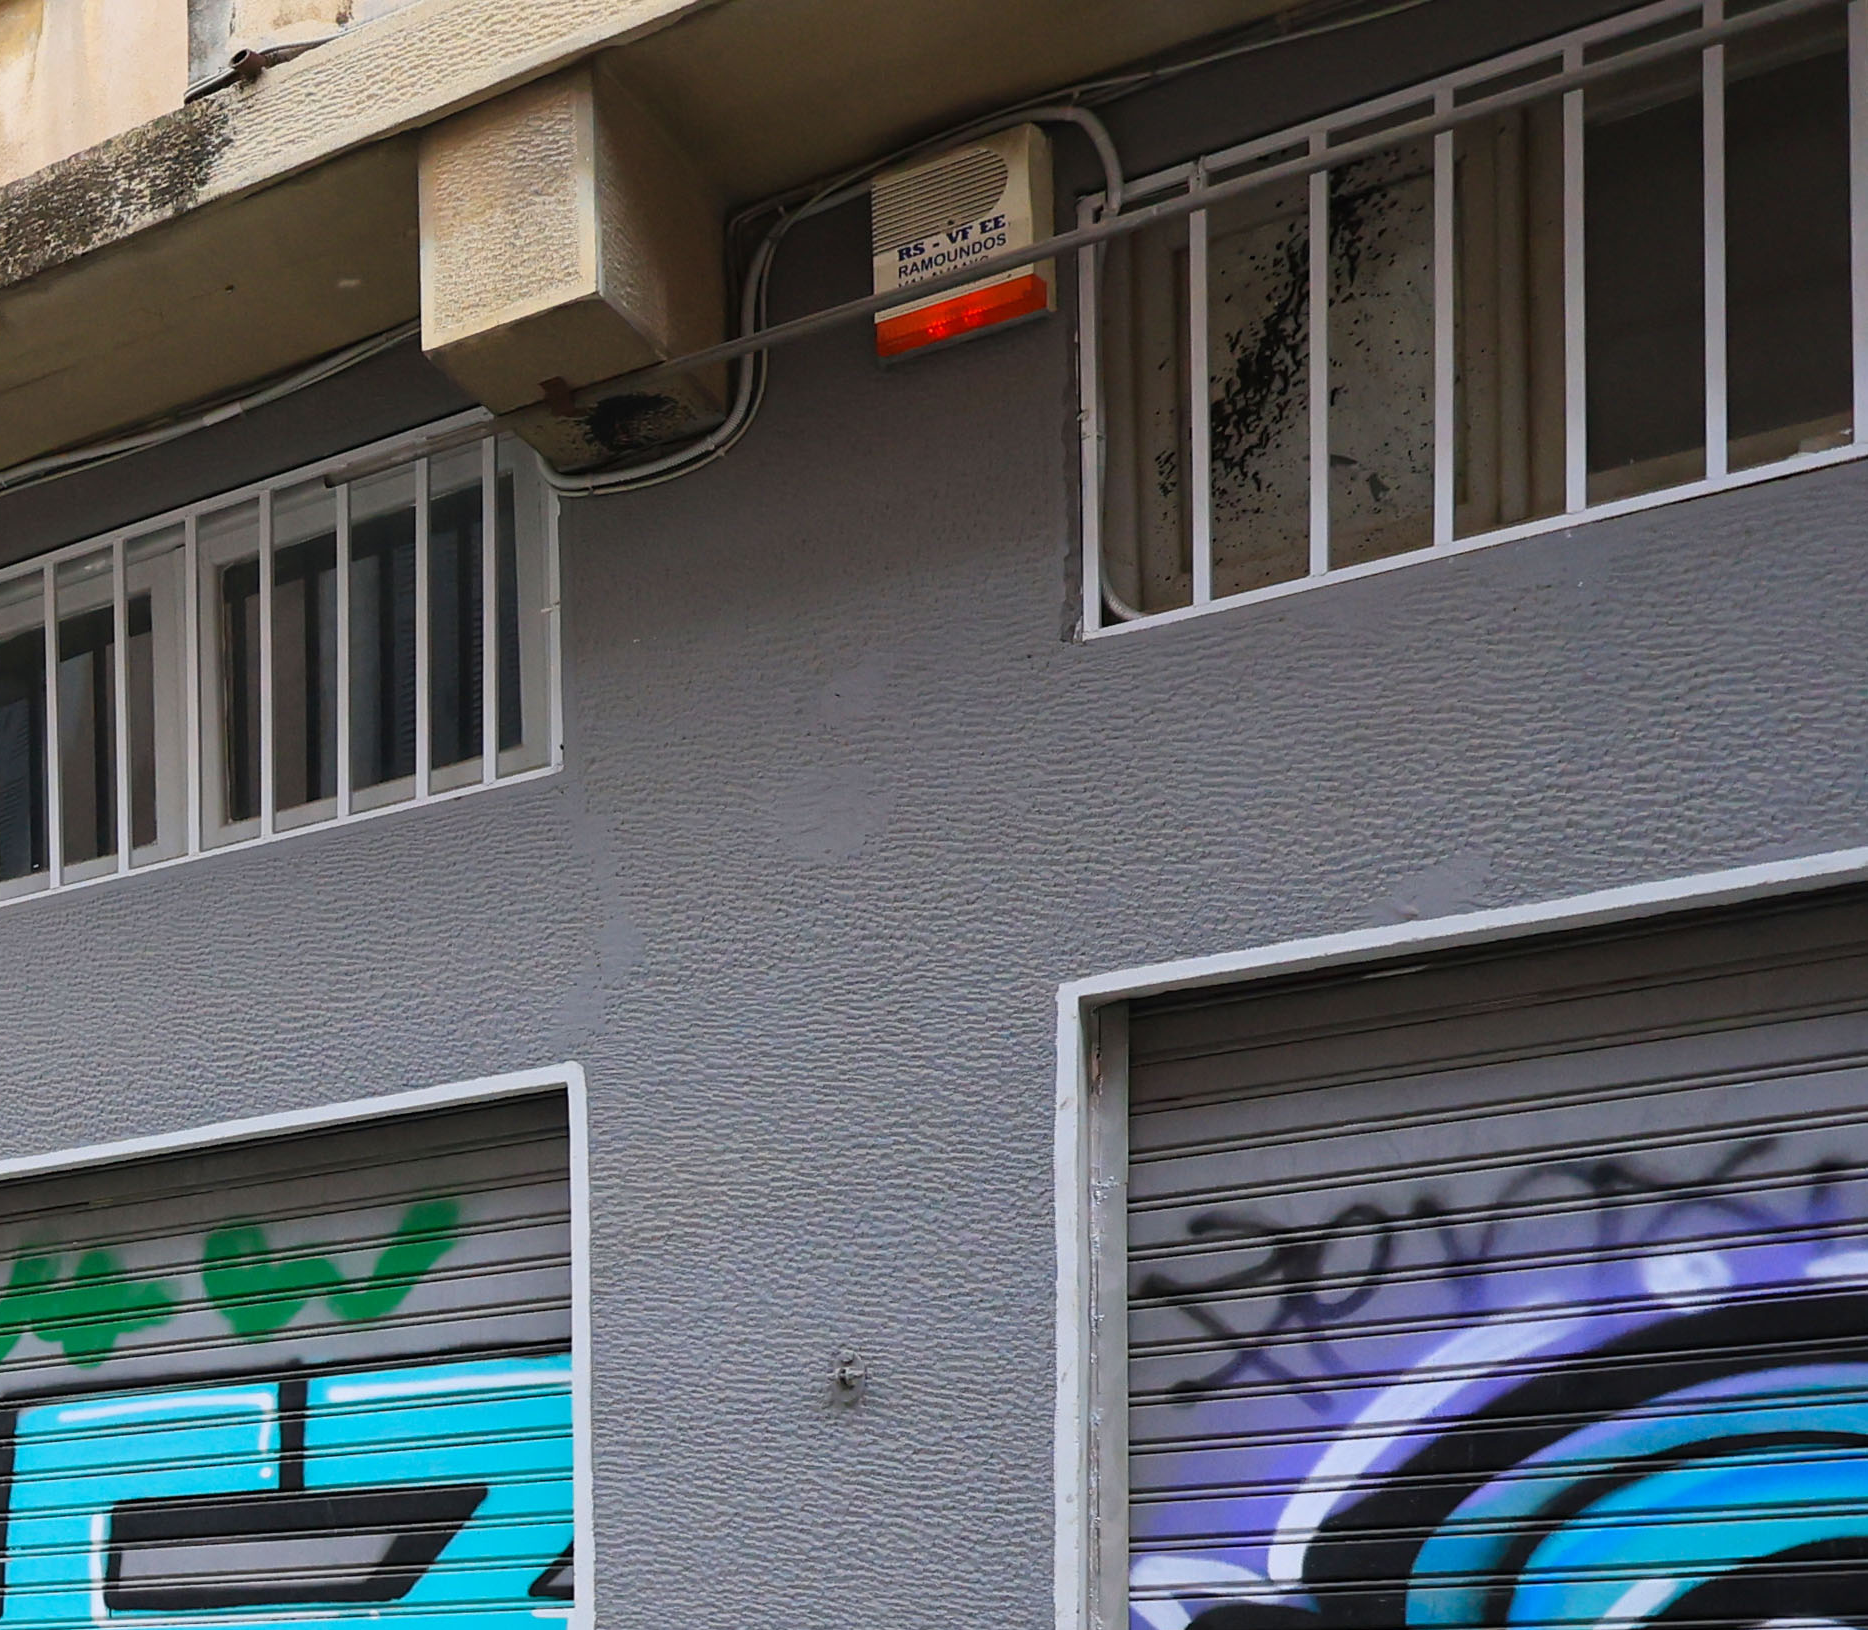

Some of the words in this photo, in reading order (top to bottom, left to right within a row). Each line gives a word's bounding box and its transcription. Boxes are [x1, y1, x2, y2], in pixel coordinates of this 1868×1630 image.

[897, 242, 925, 262] RS
[946, 225, 973, 244] VF
[979, 214, 1007, 234] EE
[898, 233, 1007, 279] RAMOUNDOS
